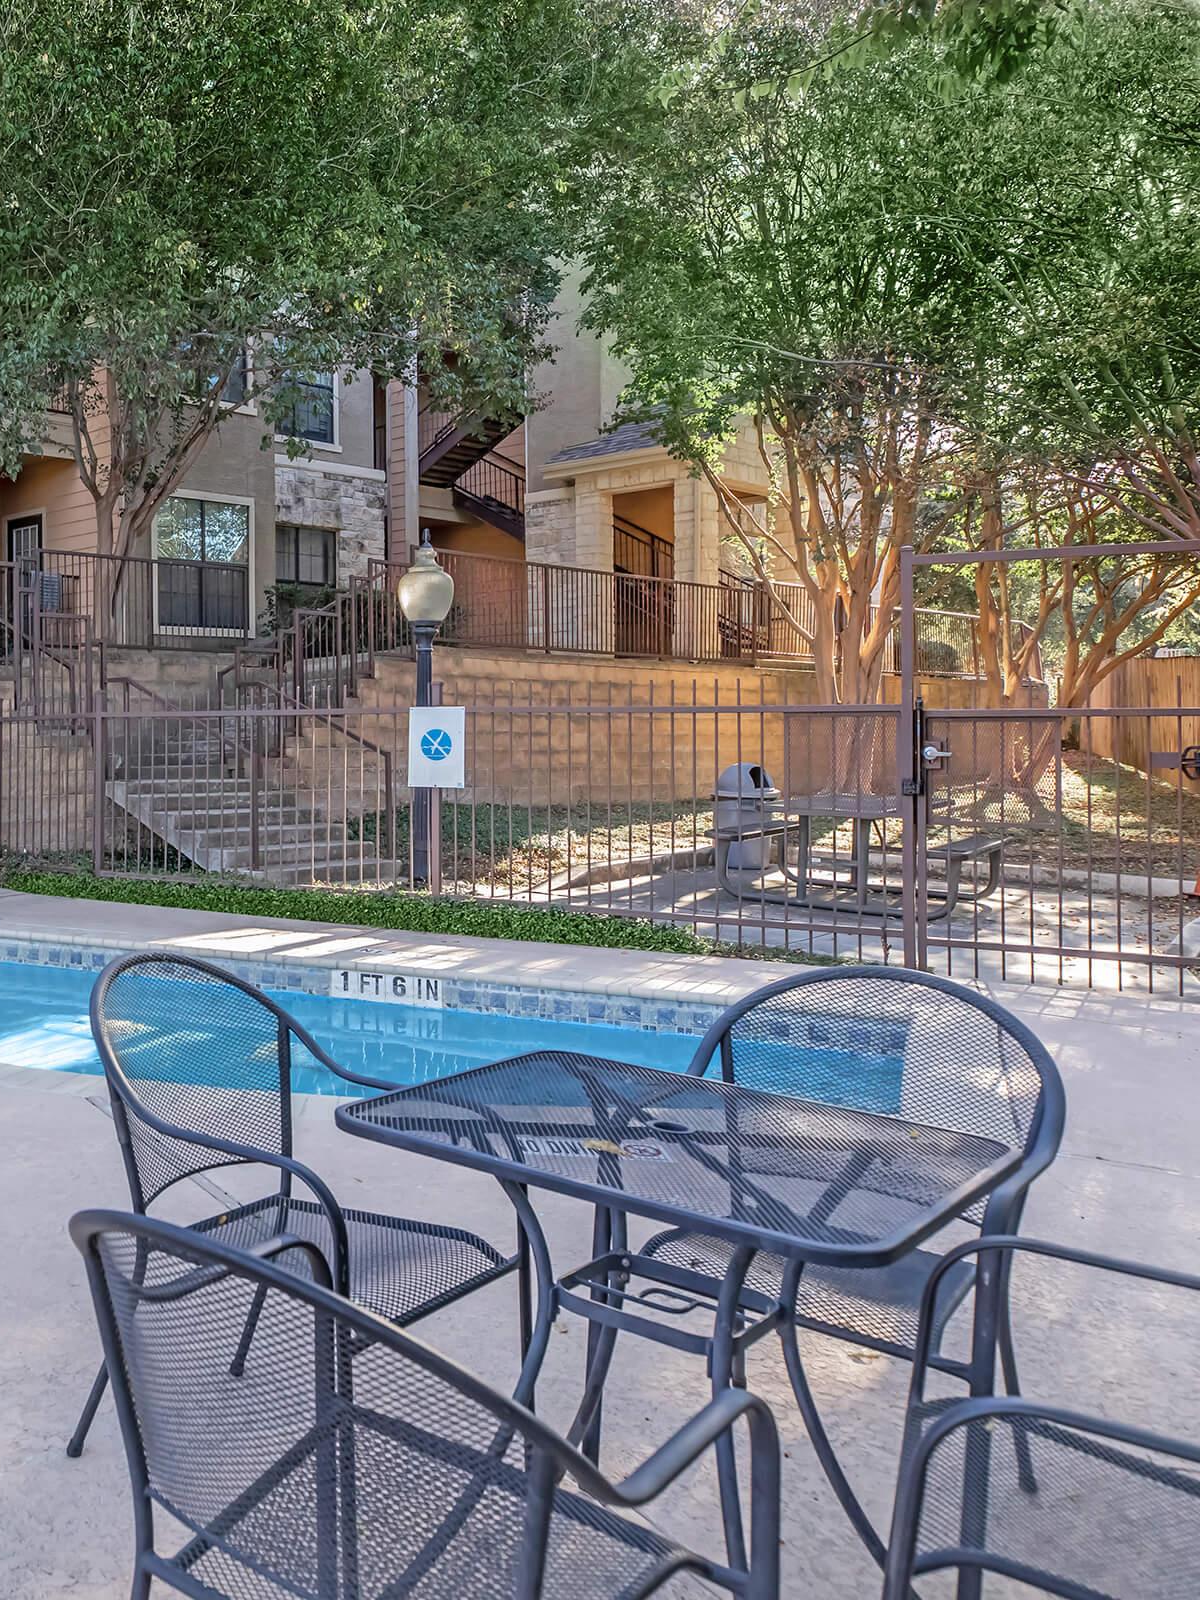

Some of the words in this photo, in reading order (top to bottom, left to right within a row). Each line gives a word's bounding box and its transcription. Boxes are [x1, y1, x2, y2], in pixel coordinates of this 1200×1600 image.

[340, 971, 349, 992] 1
[359, 973, 383, 996] FT
[392, 976, 406, 997] 6
[417, 978, 439, 1001] IN
